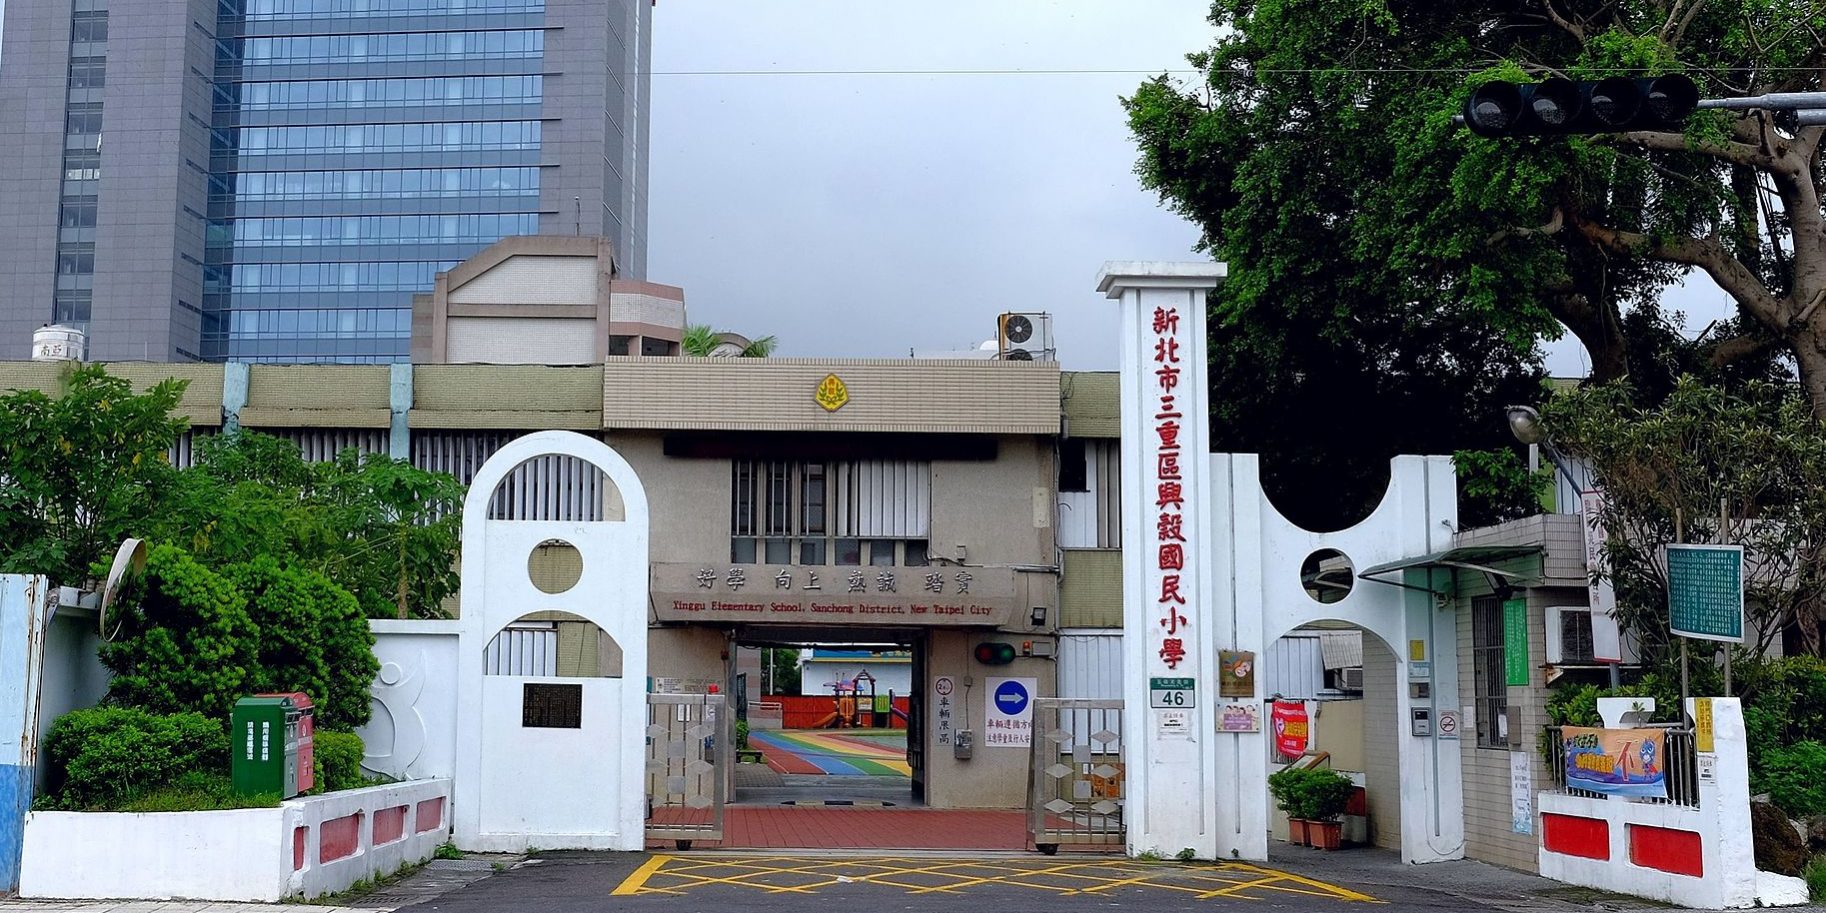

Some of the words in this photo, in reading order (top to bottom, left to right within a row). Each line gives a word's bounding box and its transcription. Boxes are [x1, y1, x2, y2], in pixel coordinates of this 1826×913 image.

[1152, 306, 1187, 670] 新北市三重區興穀國民小學
[697, 568, 746, 591] 好學
[775, 568, 821, 591] 向上
[848, 570, 896, 593] 熱誠
[925, 571, 972, 594] 踏實
[673, 600, 705, 612] Xinggu
[711, 601, 764, 613] Elementary
[810, 603, 853, 615] Sanchong
[911, 604, 928, 614] New
[934, 605, 964, 616] Taipei
[970, 605, 992, 616] City
[1162, 691, 1184, 706] 46
